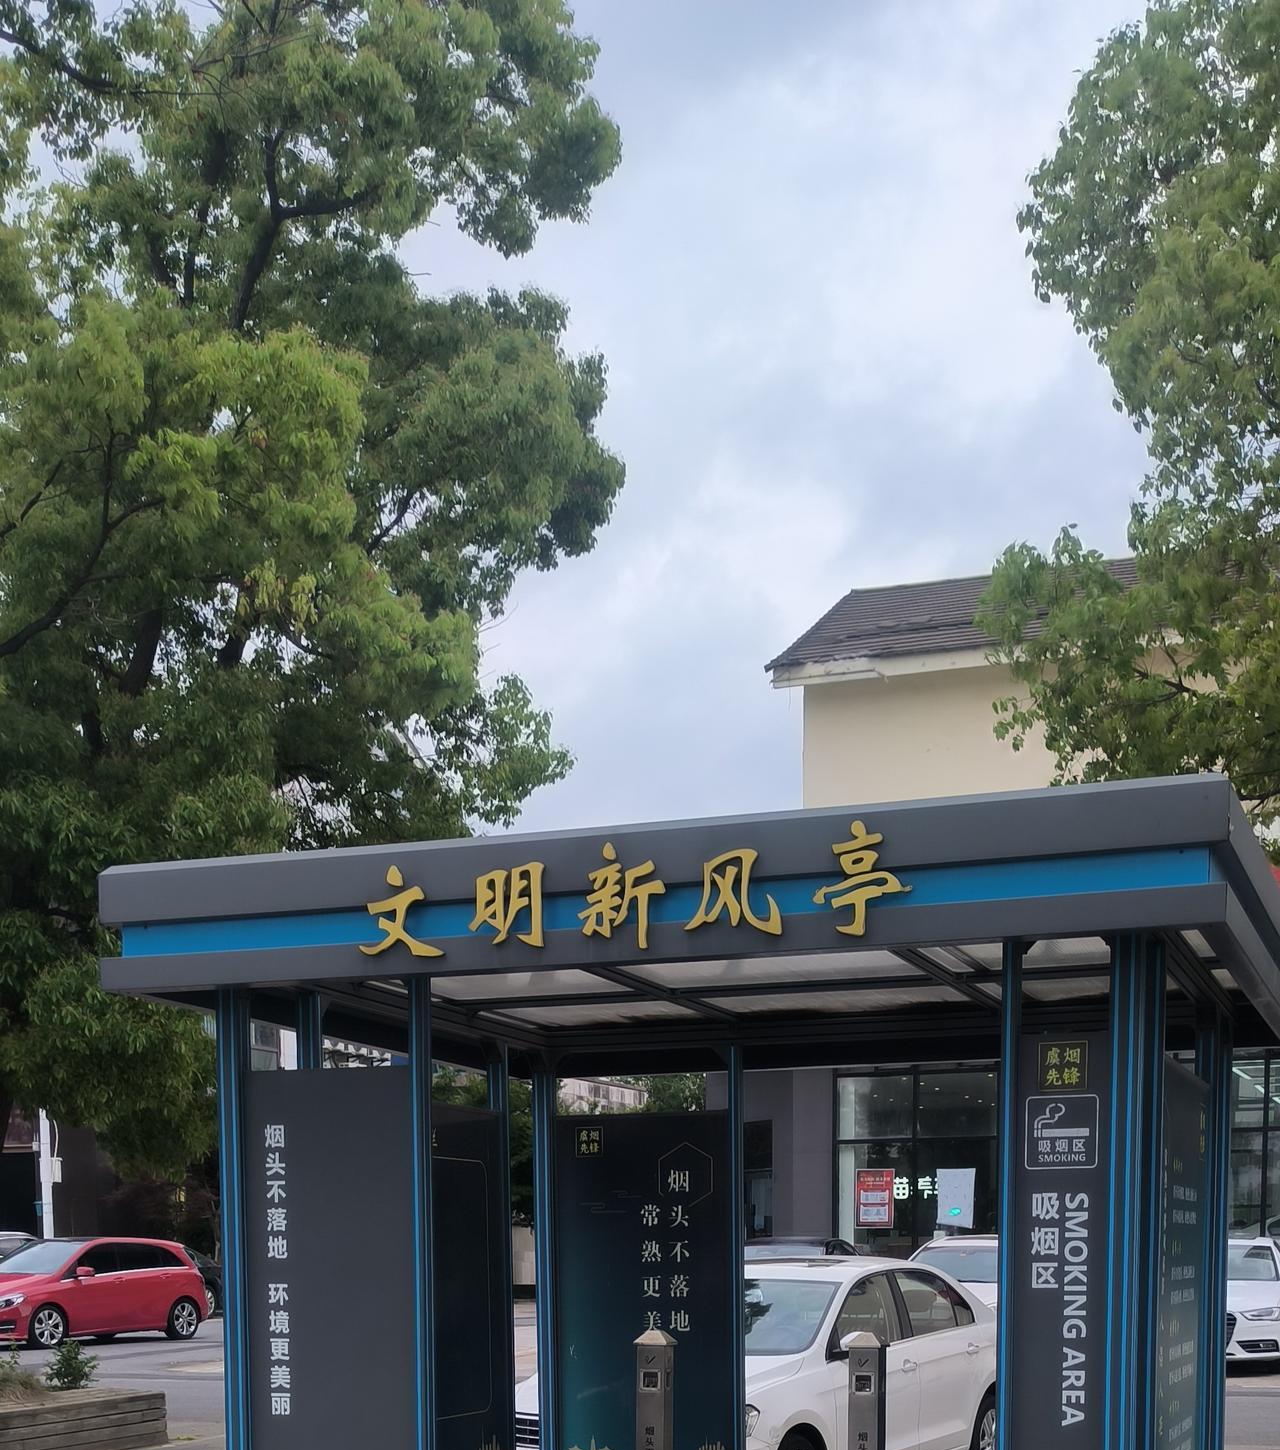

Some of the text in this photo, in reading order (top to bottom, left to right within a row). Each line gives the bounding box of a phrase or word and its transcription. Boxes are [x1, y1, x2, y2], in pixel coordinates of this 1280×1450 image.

[358, 820, 913, 957] 文明新风亭
[1044, 1067, 1081, 1086] 先锋
[1038, 1139, 1086, 1152] 吸烟区
[1038, 1153, 1086, 1163] SMOKING
[264, 1124, 291, 1415] 烟头不落地 环境更美丽
[667, 1169, 691, 1332] 烟头不落地
[1031, 1192, 1060, 1288] 吸烟区
[1061, 1192, 1089, 1426] SMOKING AREA
